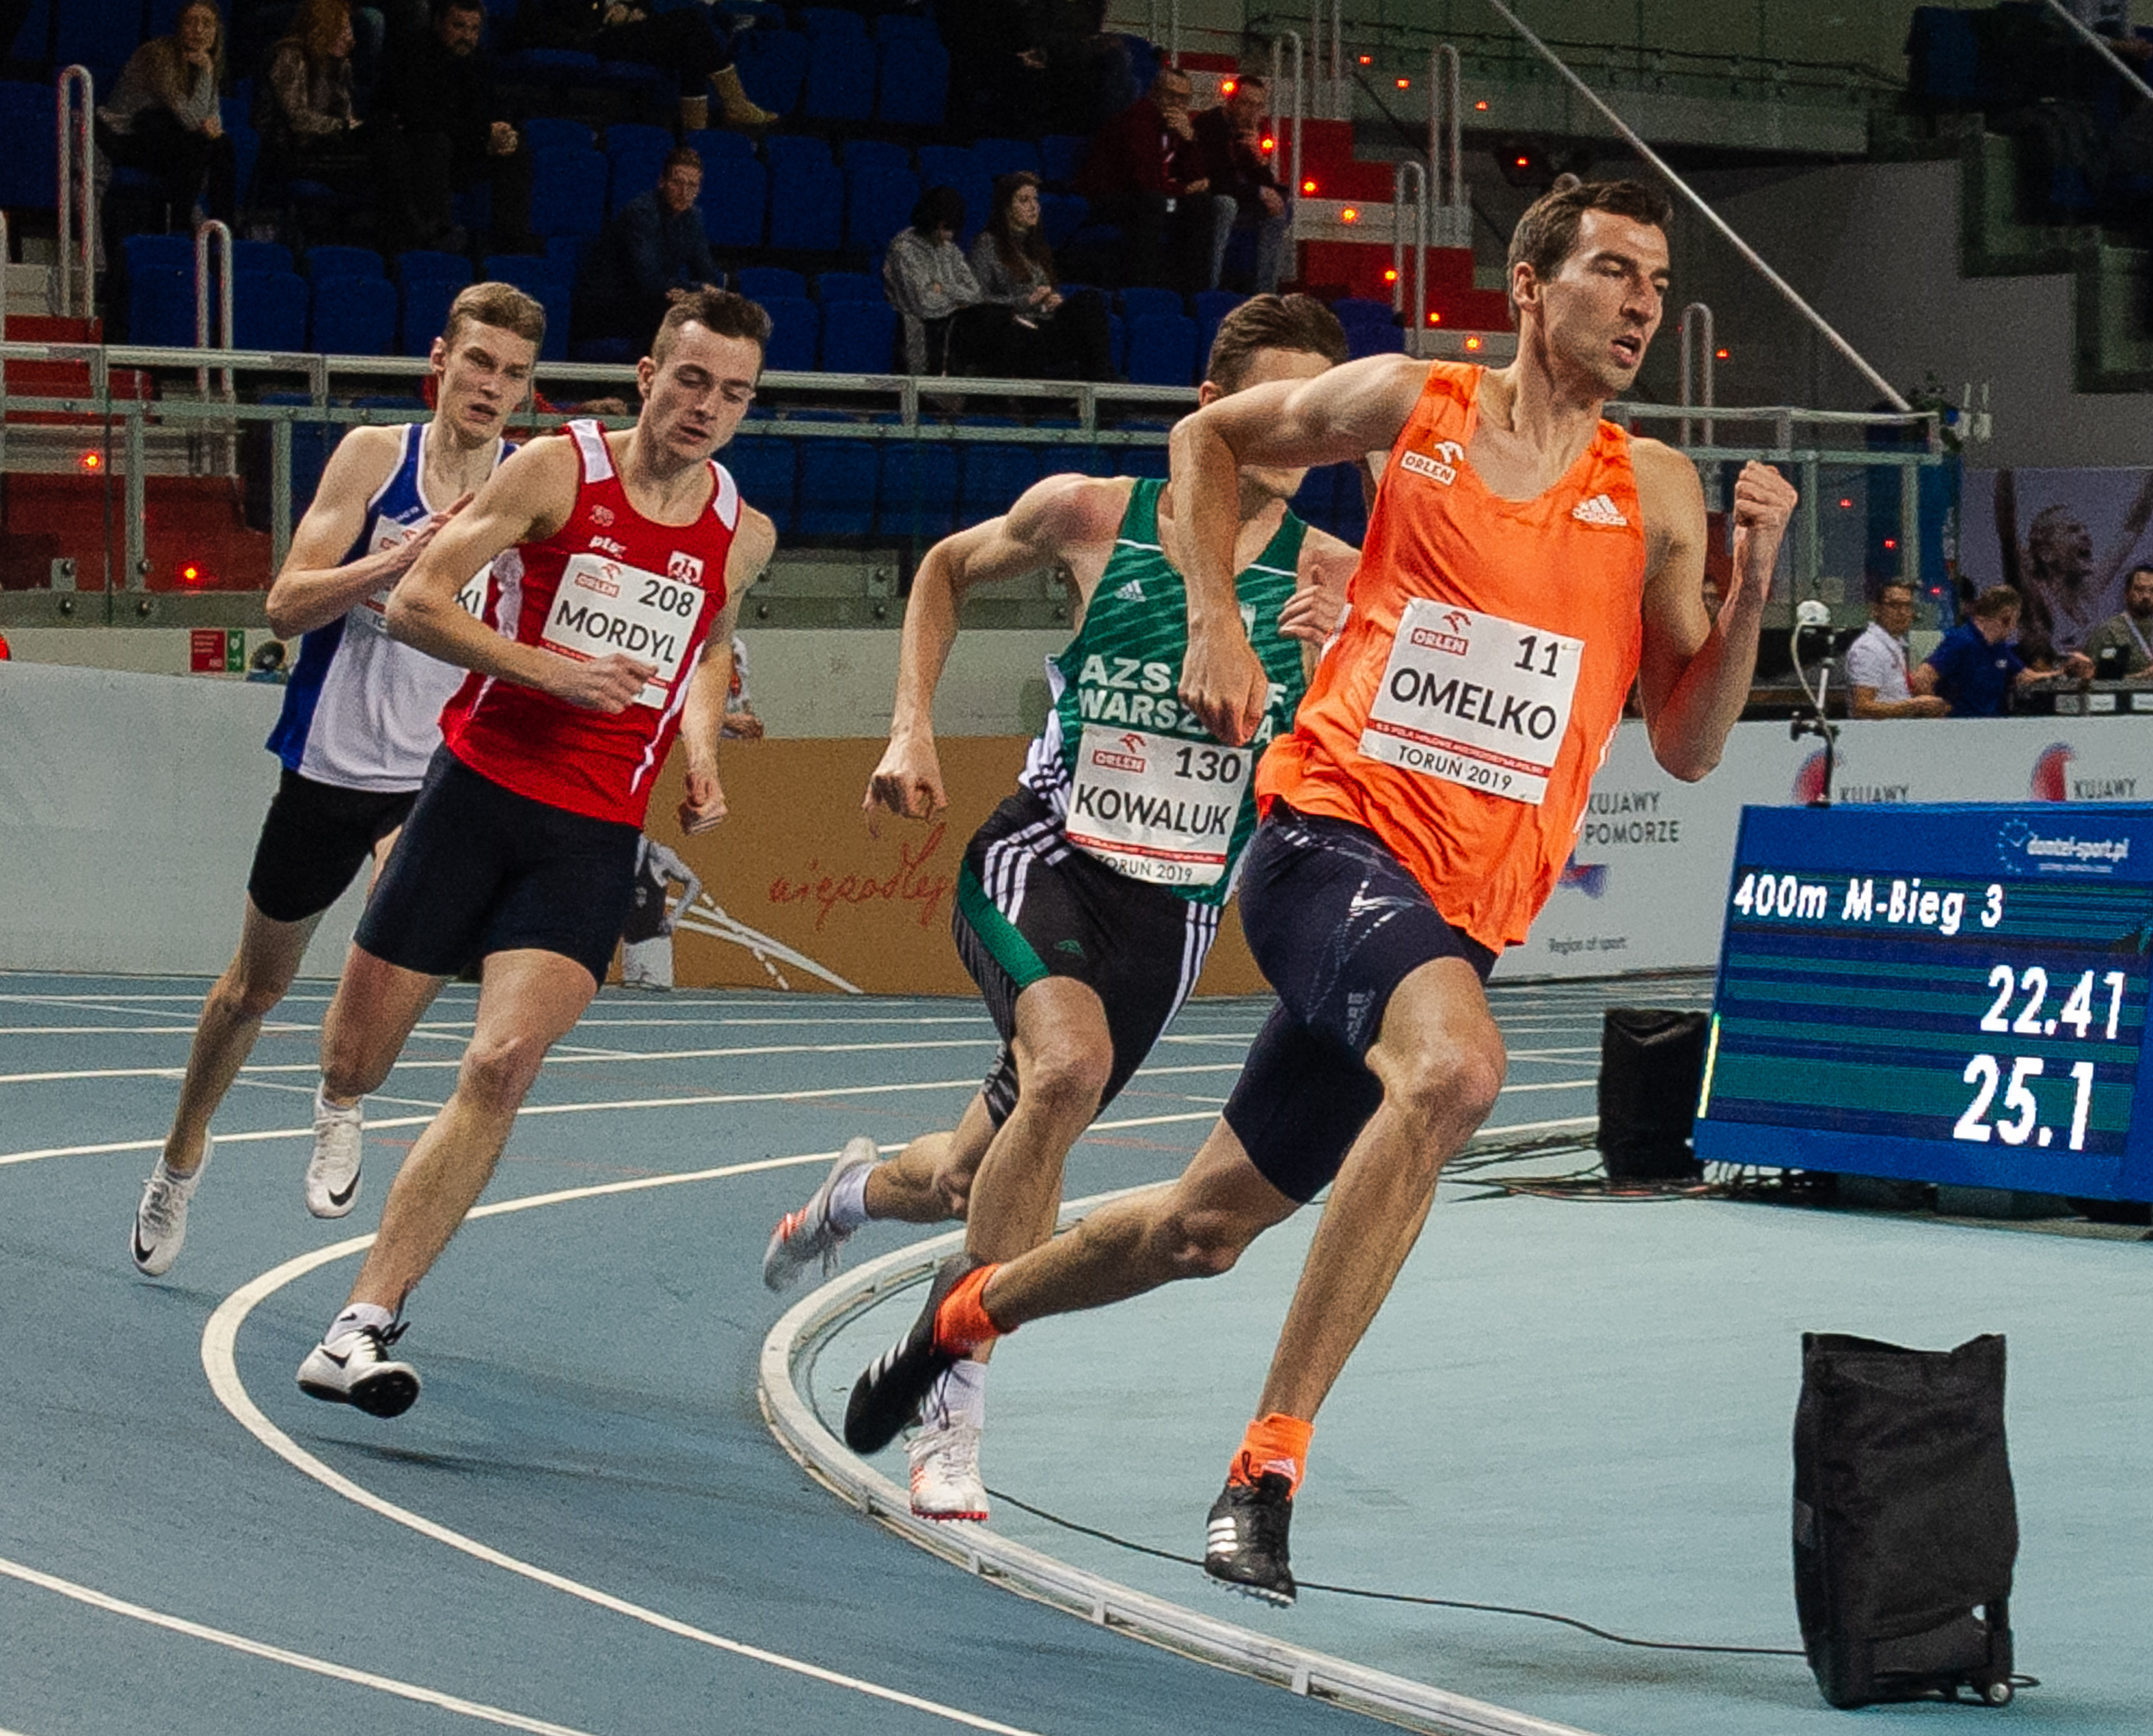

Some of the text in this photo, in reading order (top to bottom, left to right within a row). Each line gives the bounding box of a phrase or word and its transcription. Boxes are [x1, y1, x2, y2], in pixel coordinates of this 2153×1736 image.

[1404, 452, 1453, 481] ORLEN
[576, 574, 619, 597] ORLEN
[638, 579, 694, 618] 208
[556, 599, 675, 664] MORDYL
[1412, 629, 1466, 655] ORLEN
[1078, 653, 1172, 693] AZS
[1514, 634, 1559, 678] 11
[1390, 667, 1556, 740] OMELKO
[1094, 752, 1144, 773] ORLEN
[1174, 746, 1241, 783] 130
[1398, 744, 1463, 778] TORUŃ
[1467, 765, 1513, 791] 2019
[1588, 791, 1661, 815] KUJAWY
[2073, 777, 2138, 800] KUJAWY
[1075, 783, 1232, 835] KOWALUK
[1584, 820, 1681, 845] POMORZE
[1156, 864, 1193, 882] 2019
[1734, 873, 2004, 936] 400m M-Bieg 3
[1980, 964, 2127, 1041] 22.41
[1953, 1053, 2096, 1152] 25.1
